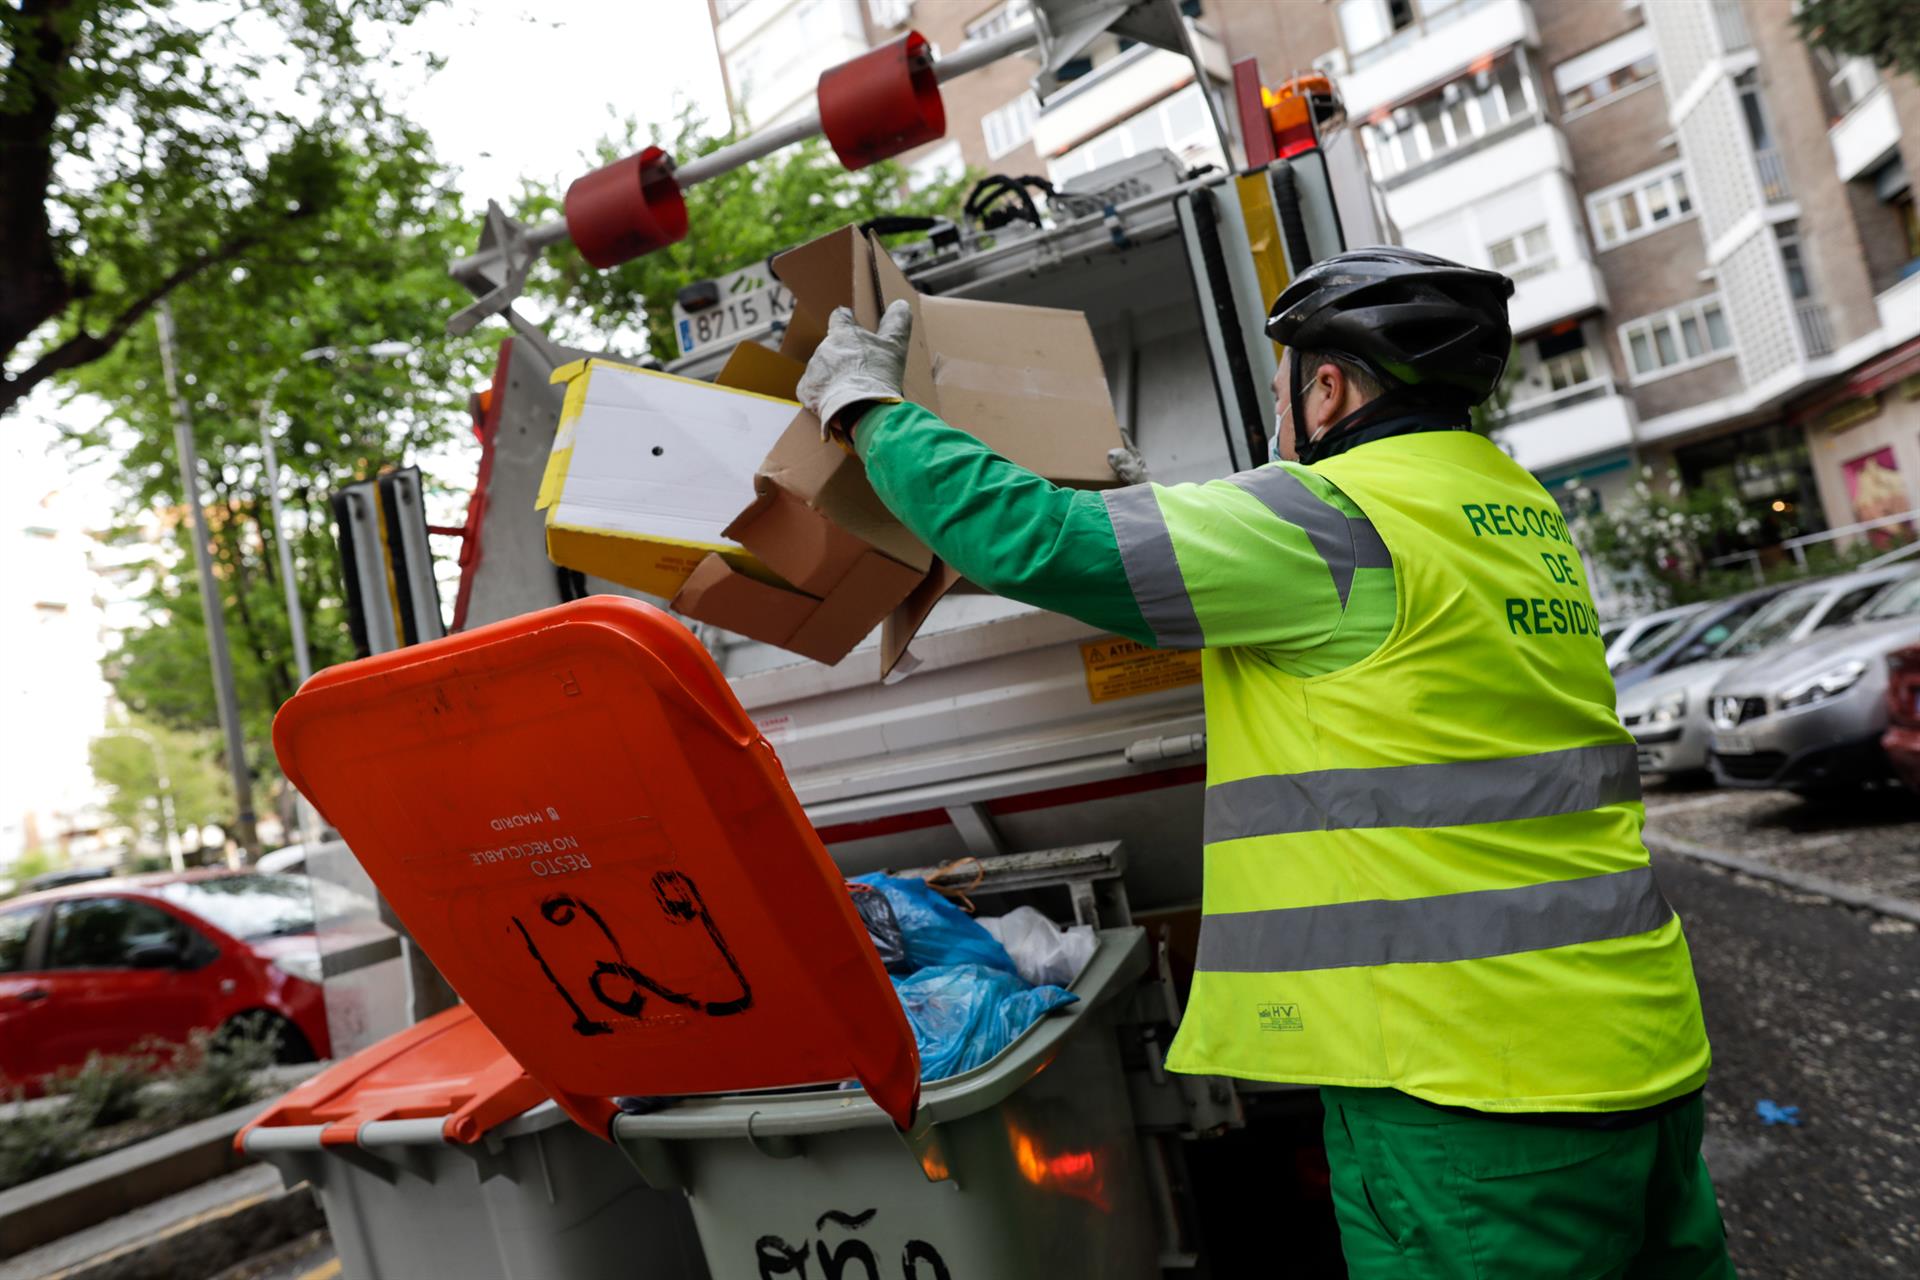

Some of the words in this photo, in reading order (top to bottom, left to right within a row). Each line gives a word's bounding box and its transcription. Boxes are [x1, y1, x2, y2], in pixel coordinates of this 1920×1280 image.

[696, 297, 759, 342] 8715
[767, 285, 797, 316] K
[1462, 504, 1574, 546] RECOGID
[1541, 552, 1579, 586] DE
[1506, 598, 1600, 638] RESIDU
[490, 812, 544, 832] MADRID
[469, 841, 553, 865] RECICLABLE
[552, 836, 579, 851] NO
[529, 853, 592, 877] RESTO
